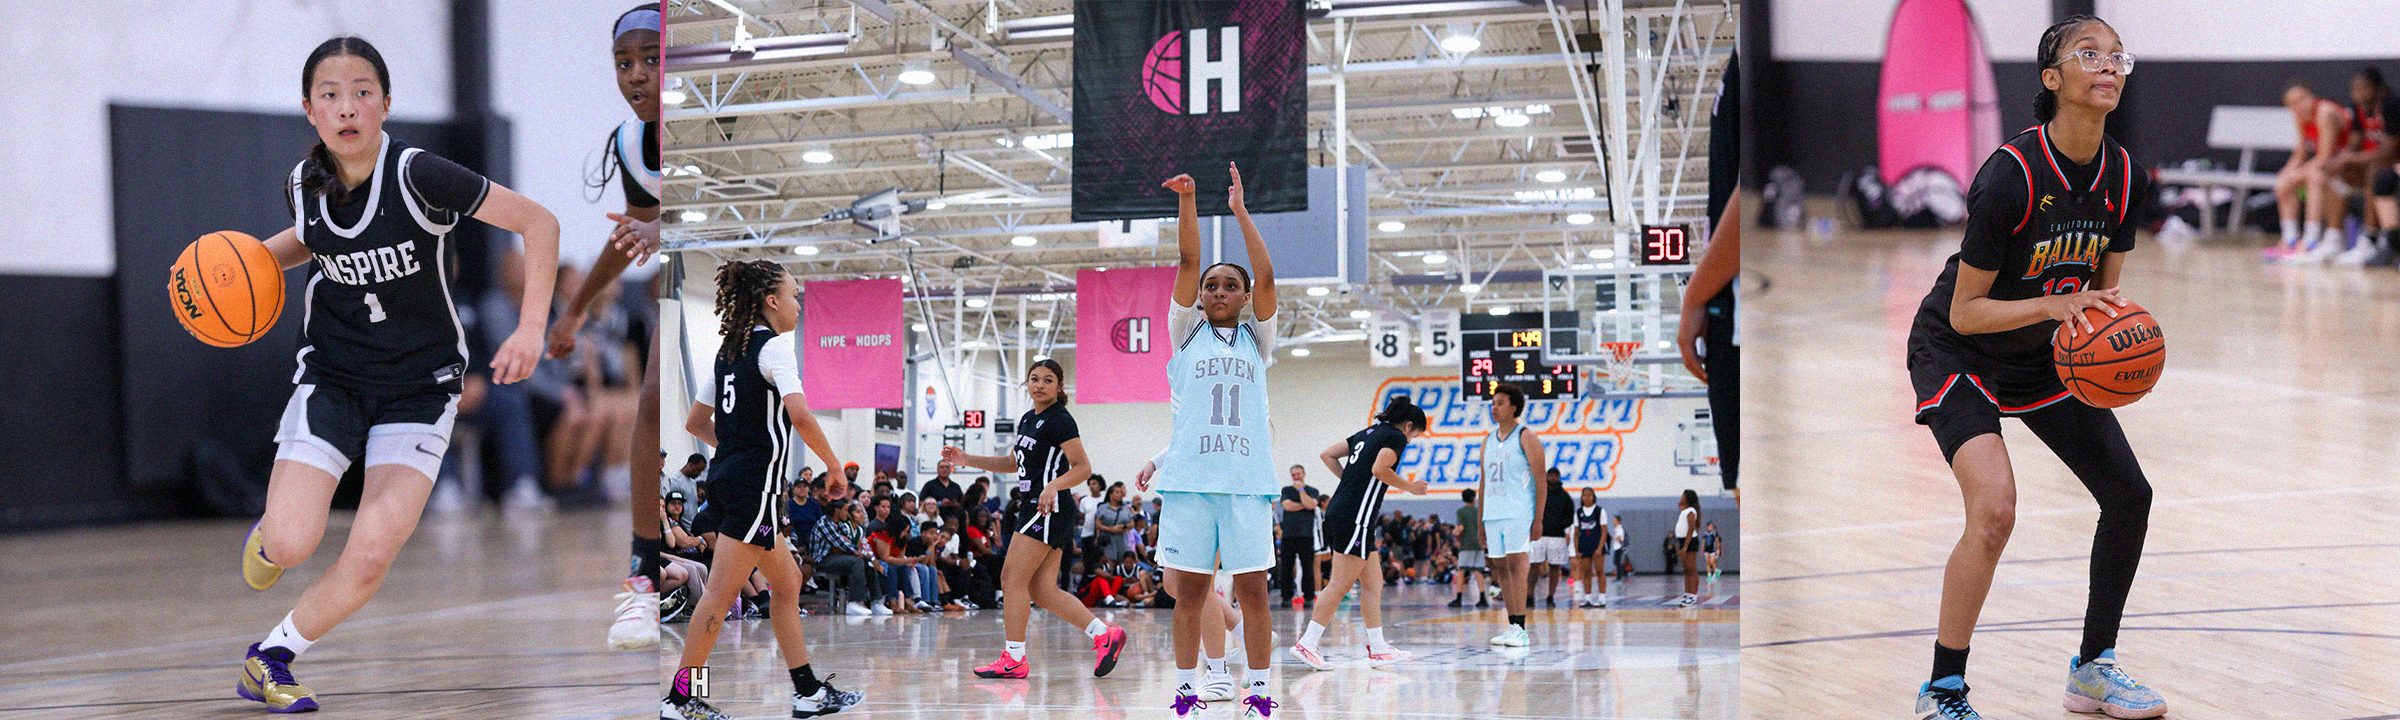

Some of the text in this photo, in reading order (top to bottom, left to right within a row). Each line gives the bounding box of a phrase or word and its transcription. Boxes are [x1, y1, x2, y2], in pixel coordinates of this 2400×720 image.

[1189, 26, 1240, 115] H
[2050, 220, 2105, 232] CALIFORNIA
[1648, 229, 1684, 260] 30
[312, 240, 421, 286] INSPIRE
[176, 266, 203, 320] NCAA
[364, 292, 387, 323] 1
[820, 333, 892, 348] HYPE HOOPS
[1129, 317, 1150, 353] H
[1382, 333, 1398, 358] 8
[1433, 331, 1449, 357] 5
[1512, 331, 1542, 347] 1:49
[1194, 357, 1255, 383] SEVEN
[1471, 358, 1493, 376] 29
[1515, 359, 1525, 374] 3
[2072, 351, 2095, 364] CITY
[722, 373, 736, 414] 5
[1543, 379, 1552, 394] 3
[1209, 382, 1241, 427] 11
[965, 410, 982, 427] 30
[1199, 434, 1250, 457] DAYS
[1349, 441, 1365, 464] 3
[1394, 441, 1613, 483] PREER
[1489, 462, 1505, 482] 21
